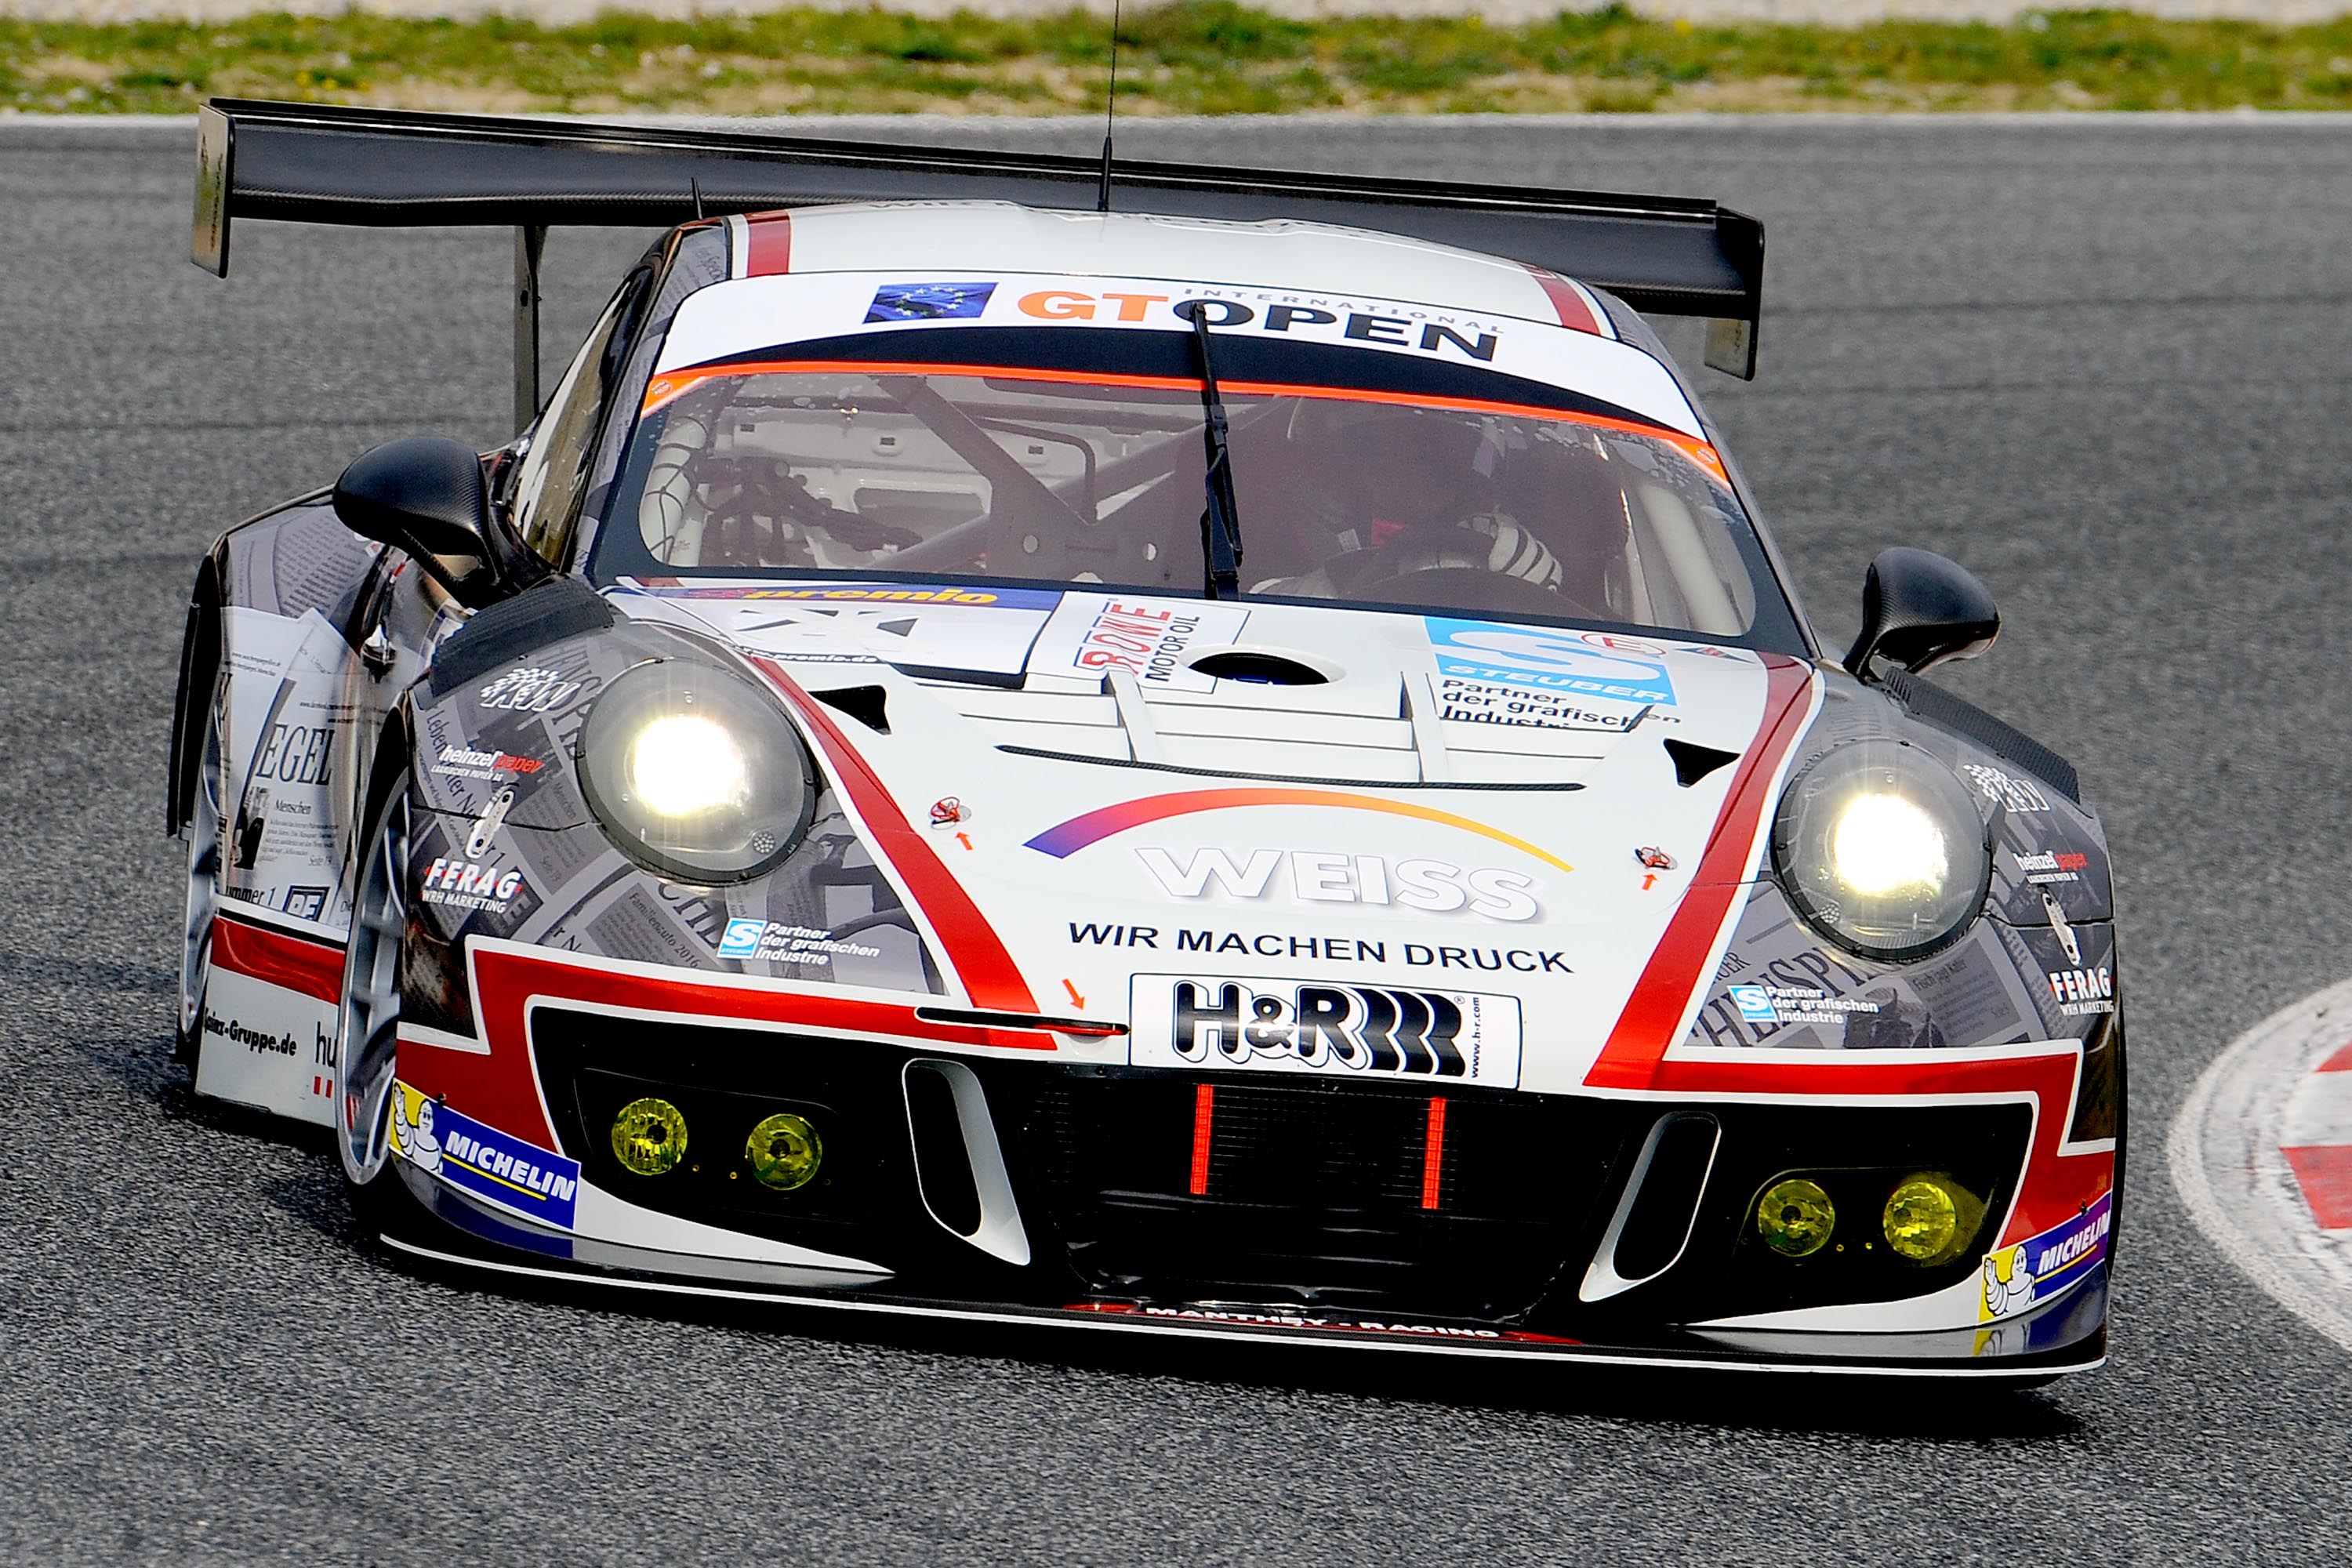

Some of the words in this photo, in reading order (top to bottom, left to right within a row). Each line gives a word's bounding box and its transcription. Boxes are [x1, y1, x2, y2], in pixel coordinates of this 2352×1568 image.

[1184, 289, 1504, 334] INTERNATIONAL
[743, 588, 998, 604] premio
[1145, 636, 1189, 682] MOTOR
[1169, 616, 1200, 633] OIL
[1442, 680, 1567, 705] Partner
[1443, 666, 1668, 701] STEUBER
[1442, 691, 1498, 706] der
[424, 858, 522, 899] FERAG
[1134, 847, 1539, 922] WEISS
[421, 889, 444, 903] WRH
[444, 892, 507, 914] MARKETING
[764, 922, 831, 939] Partner
[673, 941, 704, 969] 2016
[754, 947, 829, 965] Industrie
[760, 934, 791, 946] der
[789, 938, 881, 958] grafischen
[1068, 922, 1160, 949] WIR
[1176, 929, 1386, 964] MACHEN
[1404, 943, 1575, 975] DRUCK
[1766, 985, 1824, 999] Partner
[2049, 967, 2112, 1002] FERAG
[1772, 996, 1798, 1009] der
[1802, 998, 1880, 1014] grafischen
[1778, 1009, 1843, 1024] Industrie
[1174, 980, 1369, 1069] H&R
[1471, 996, 1481, 1079] www.h-r.com
[445, 1130, 577, 1202] MICHELIN
[2037, 1208, 2111, 1276] MICHELIN
[1146, 1307, 1328, 1327] MANTHEY
